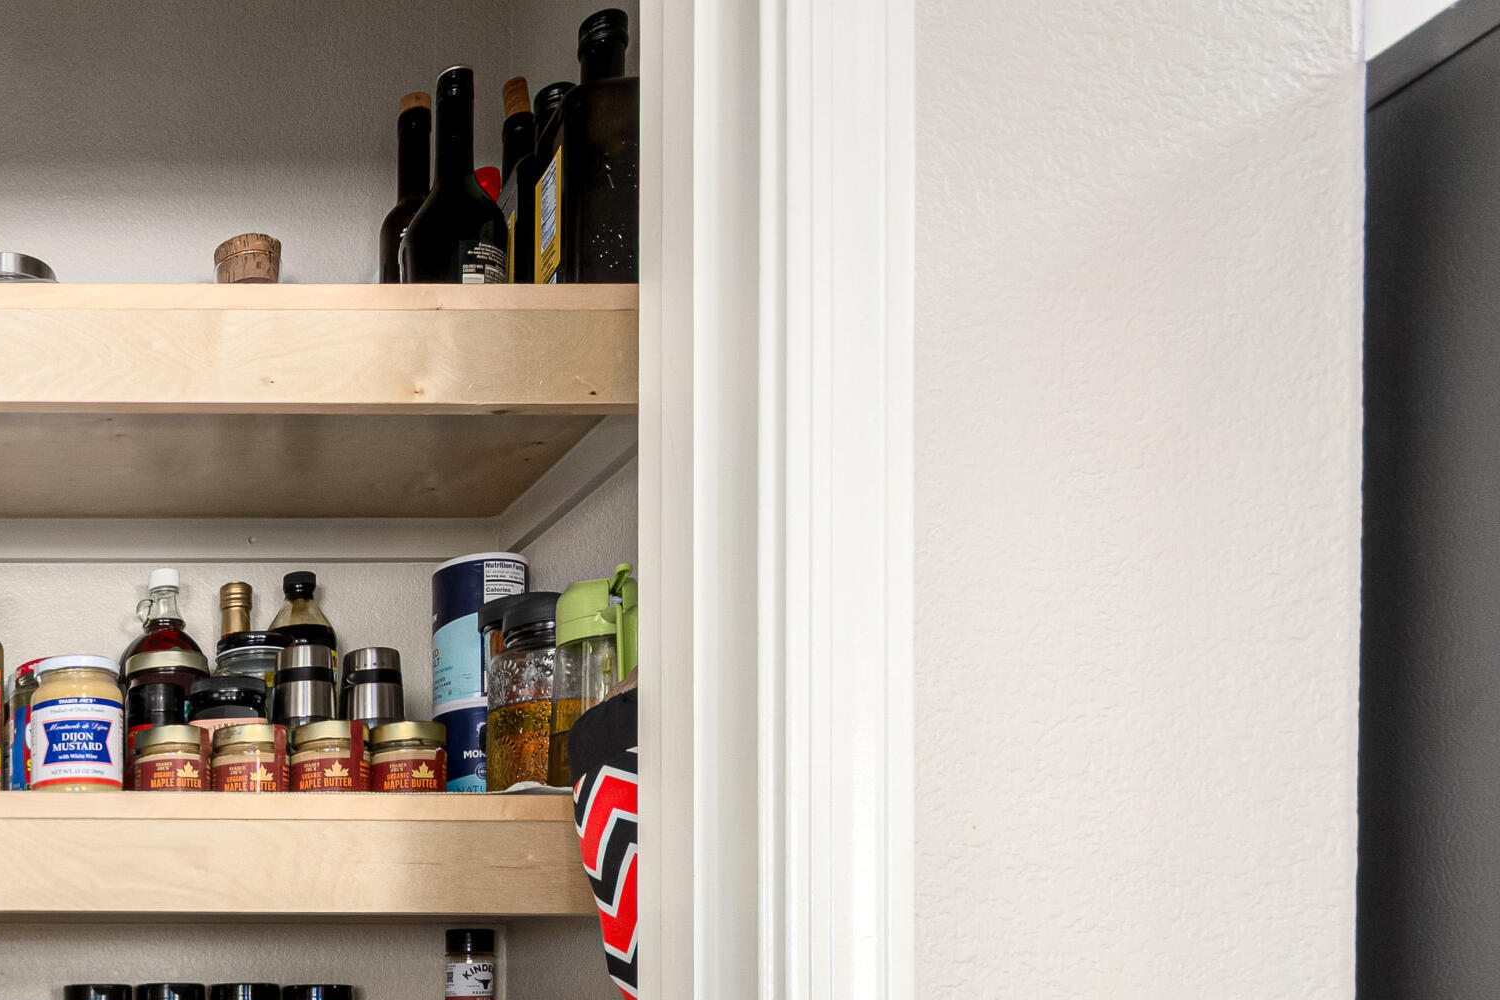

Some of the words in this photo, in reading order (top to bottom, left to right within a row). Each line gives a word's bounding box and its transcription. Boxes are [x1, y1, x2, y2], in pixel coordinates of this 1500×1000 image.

[62, 732, 94, 742] DIJON
[52, 742, 103, 752] MUSTARD
[150, 778, 174, 788] MAPLE
[177, 778, 202, 788] BUTTER
[224, 782, 247, 791] MAPLE
[250, 782, 276, 791] BUTTER
[300, 779, 322, 790] MAPLE
[324, 778, 352, 787] BUTTER
[384, 780, 409, 790] MAPLE
[412, 779, 437, 788] BUTTER
